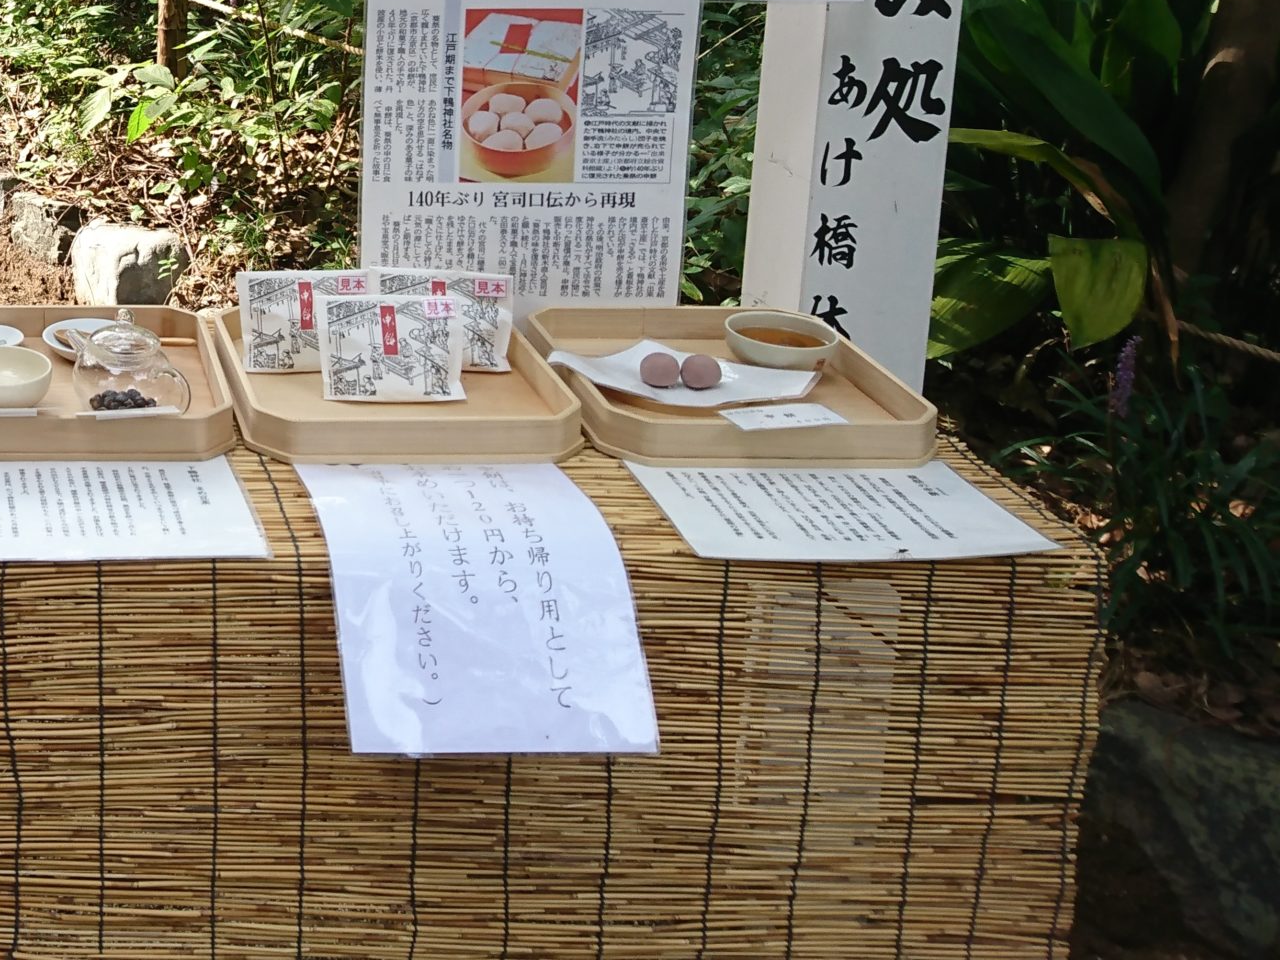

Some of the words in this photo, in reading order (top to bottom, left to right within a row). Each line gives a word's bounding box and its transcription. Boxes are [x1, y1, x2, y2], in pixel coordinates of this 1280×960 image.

[441, 33, 458, 151] 江戸期まで下鴨神社名物
[407, 190, 485, 207] 140年ぶり
[492, 190, 636, 208] 宮司口伝から再現
[339, 276, 366, 291] 見本
[477, 281, 505, 296] 見本
[426, 300, 455, 315] 見本
